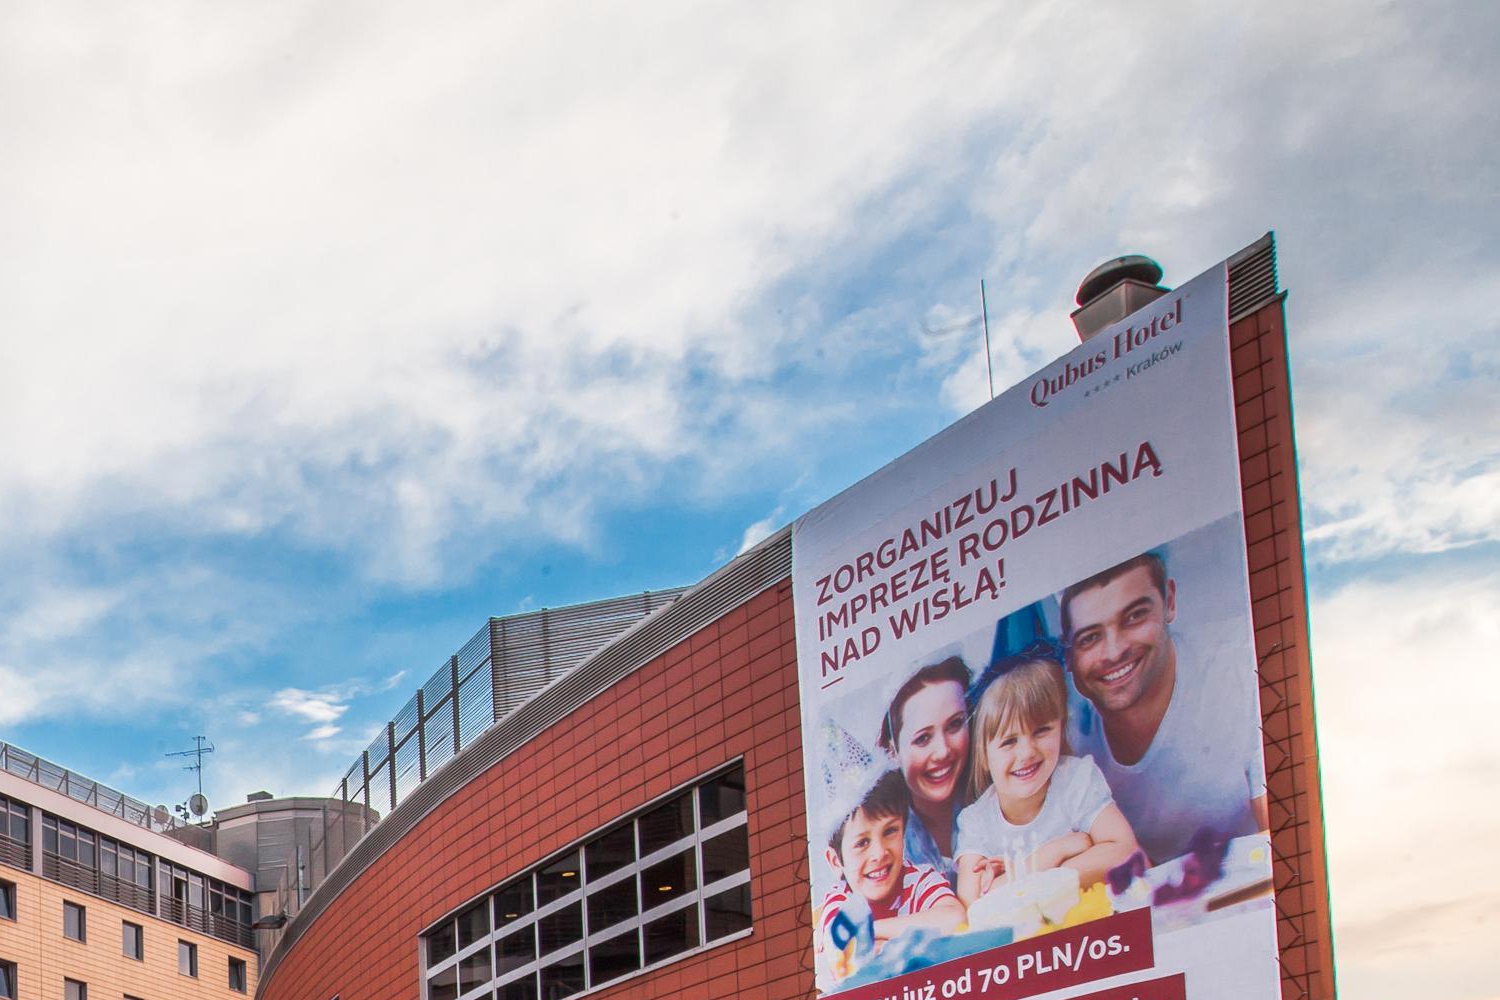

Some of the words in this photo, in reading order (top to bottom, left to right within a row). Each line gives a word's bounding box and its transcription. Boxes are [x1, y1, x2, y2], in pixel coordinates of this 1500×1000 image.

[1029, 350, 1106, 408] Qubus
[1113, 298, 1183, 361] Hotel
[1126, 341, 1183, 379] Kraków
[815, 468, 1018, 606] ZORGANIZUJ
[818, 548, 950, 642] IMPREZĘ
[958, 441, 1164, 566] RODZINNĄ
[821, 626, 882, 677] NAD
[889, 559, 1006, 640] WISŁĄ!
[941, 970, 972, 1000] od
[978, 963, 1010, 994] 70
[1017, 933, 1131, 981] PLN/os.
